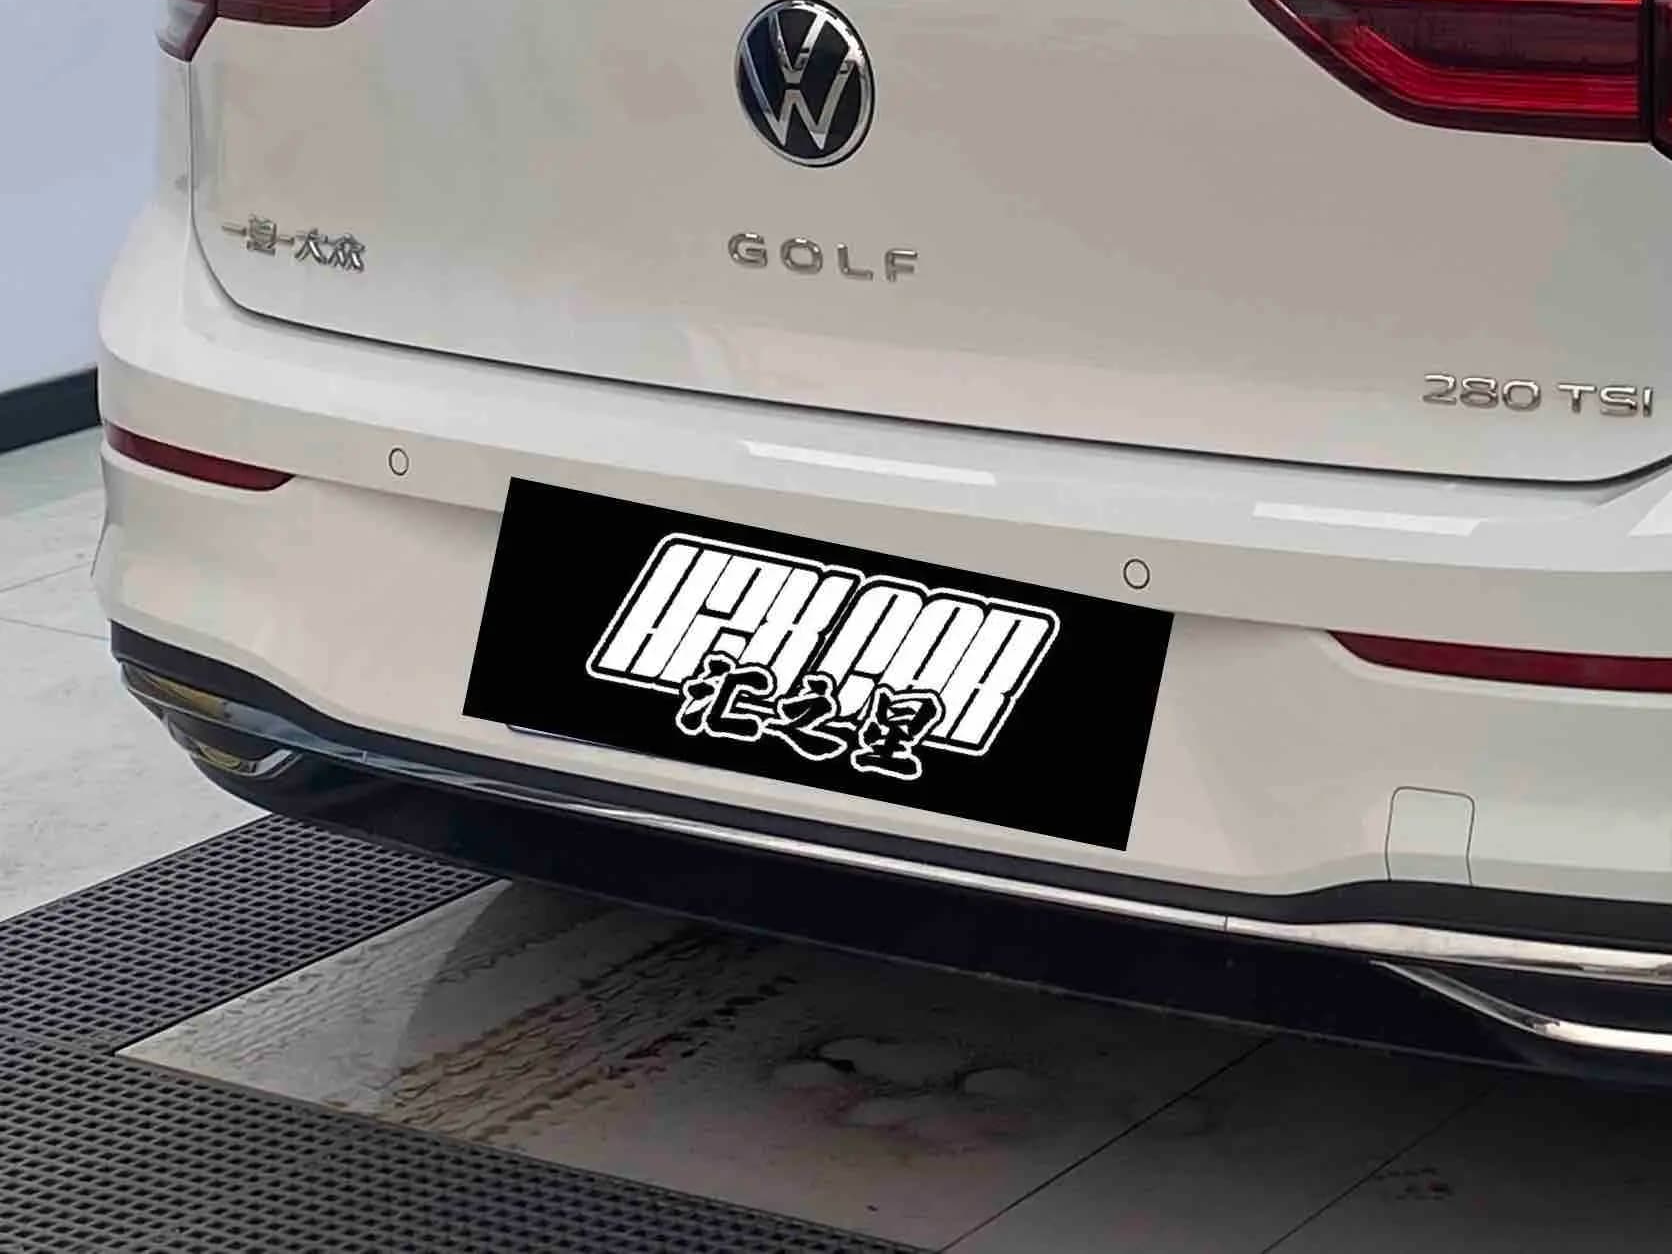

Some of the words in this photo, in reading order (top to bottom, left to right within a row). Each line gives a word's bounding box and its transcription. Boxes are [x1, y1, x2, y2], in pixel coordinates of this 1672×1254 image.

[727, 232, 919, 283] GOLF
[1422, 372, 1541, 411] 280
[1556, 382, 1653, 418] TSI
